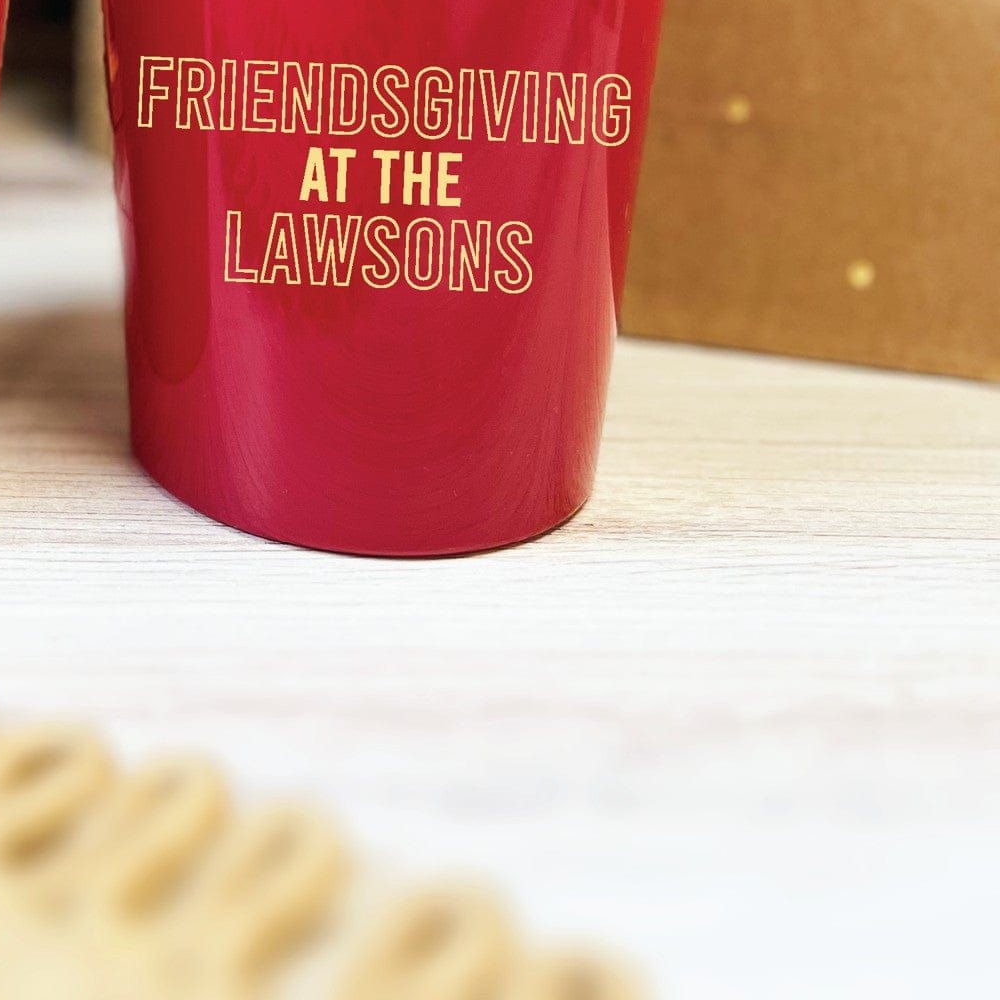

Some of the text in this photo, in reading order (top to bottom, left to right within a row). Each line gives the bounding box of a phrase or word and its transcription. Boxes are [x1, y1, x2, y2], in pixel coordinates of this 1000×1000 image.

[137, 55, 632, 147] FRIENDSGIVING
[299, 147, 464, 207] AT THE
[224, 210, 534, 294] LAWSONS
